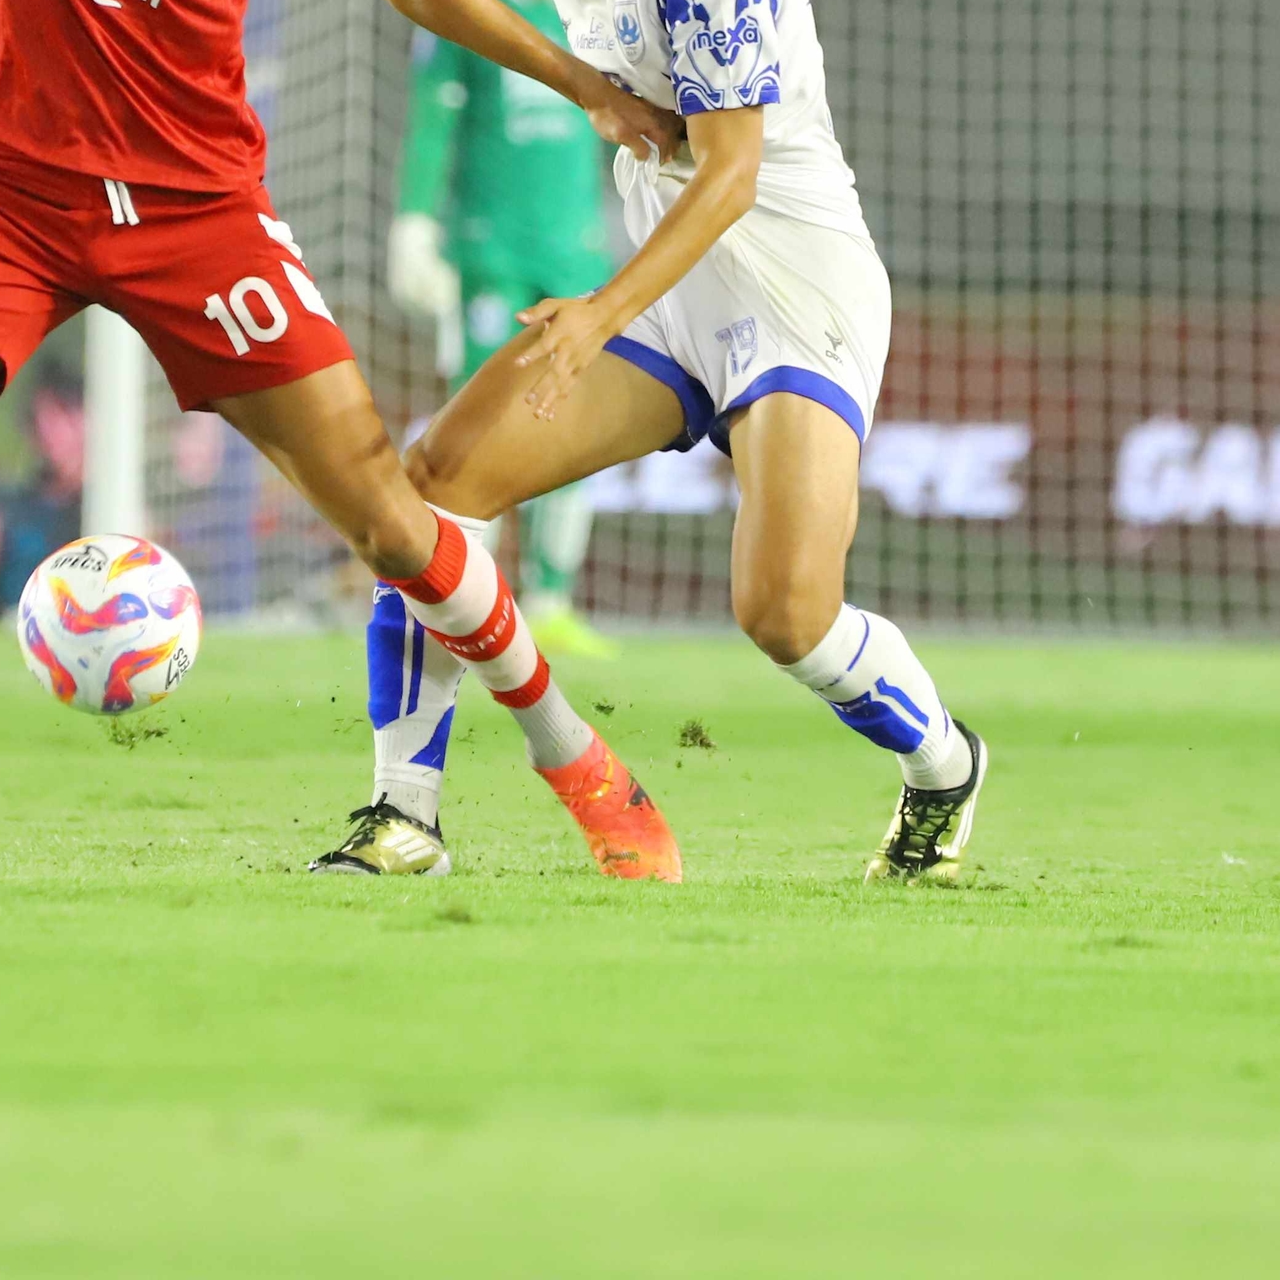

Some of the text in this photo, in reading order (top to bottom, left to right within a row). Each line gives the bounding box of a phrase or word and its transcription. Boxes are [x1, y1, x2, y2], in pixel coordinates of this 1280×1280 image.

[590, 16, 605, 34] Le
[204, 276, 289, 357] 10
[50, 556, 108, 572] SPECS
